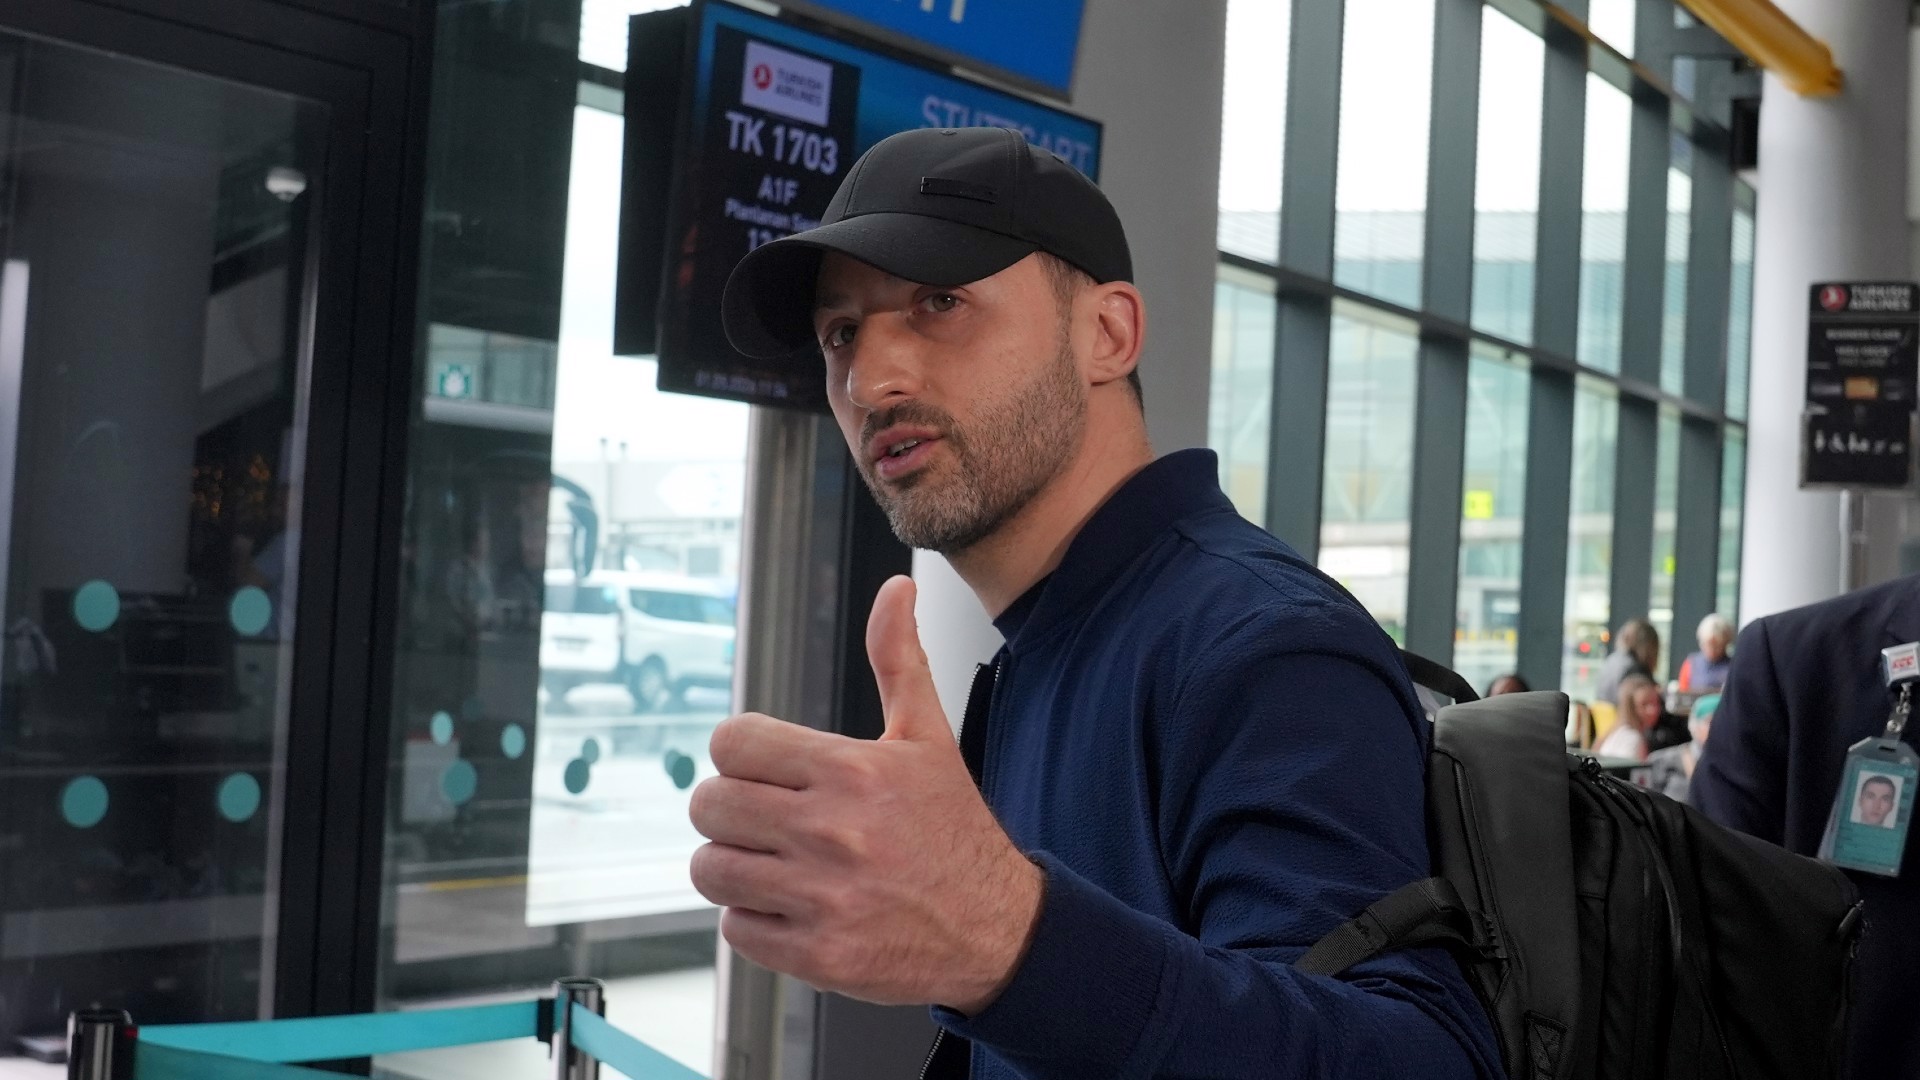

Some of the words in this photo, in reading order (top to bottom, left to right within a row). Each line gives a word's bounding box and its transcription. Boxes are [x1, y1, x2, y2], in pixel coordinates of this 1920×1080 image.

[725, 110, 766, 157] TK
[772, 124, 840, 176] 1703
[920, 95, 1092, 173] STURT
[757, 173, 800, 206] A1F
[1848, 298, 1911, 311] AIRLINES
[1851, 285, 1911, 297] TURKISH
